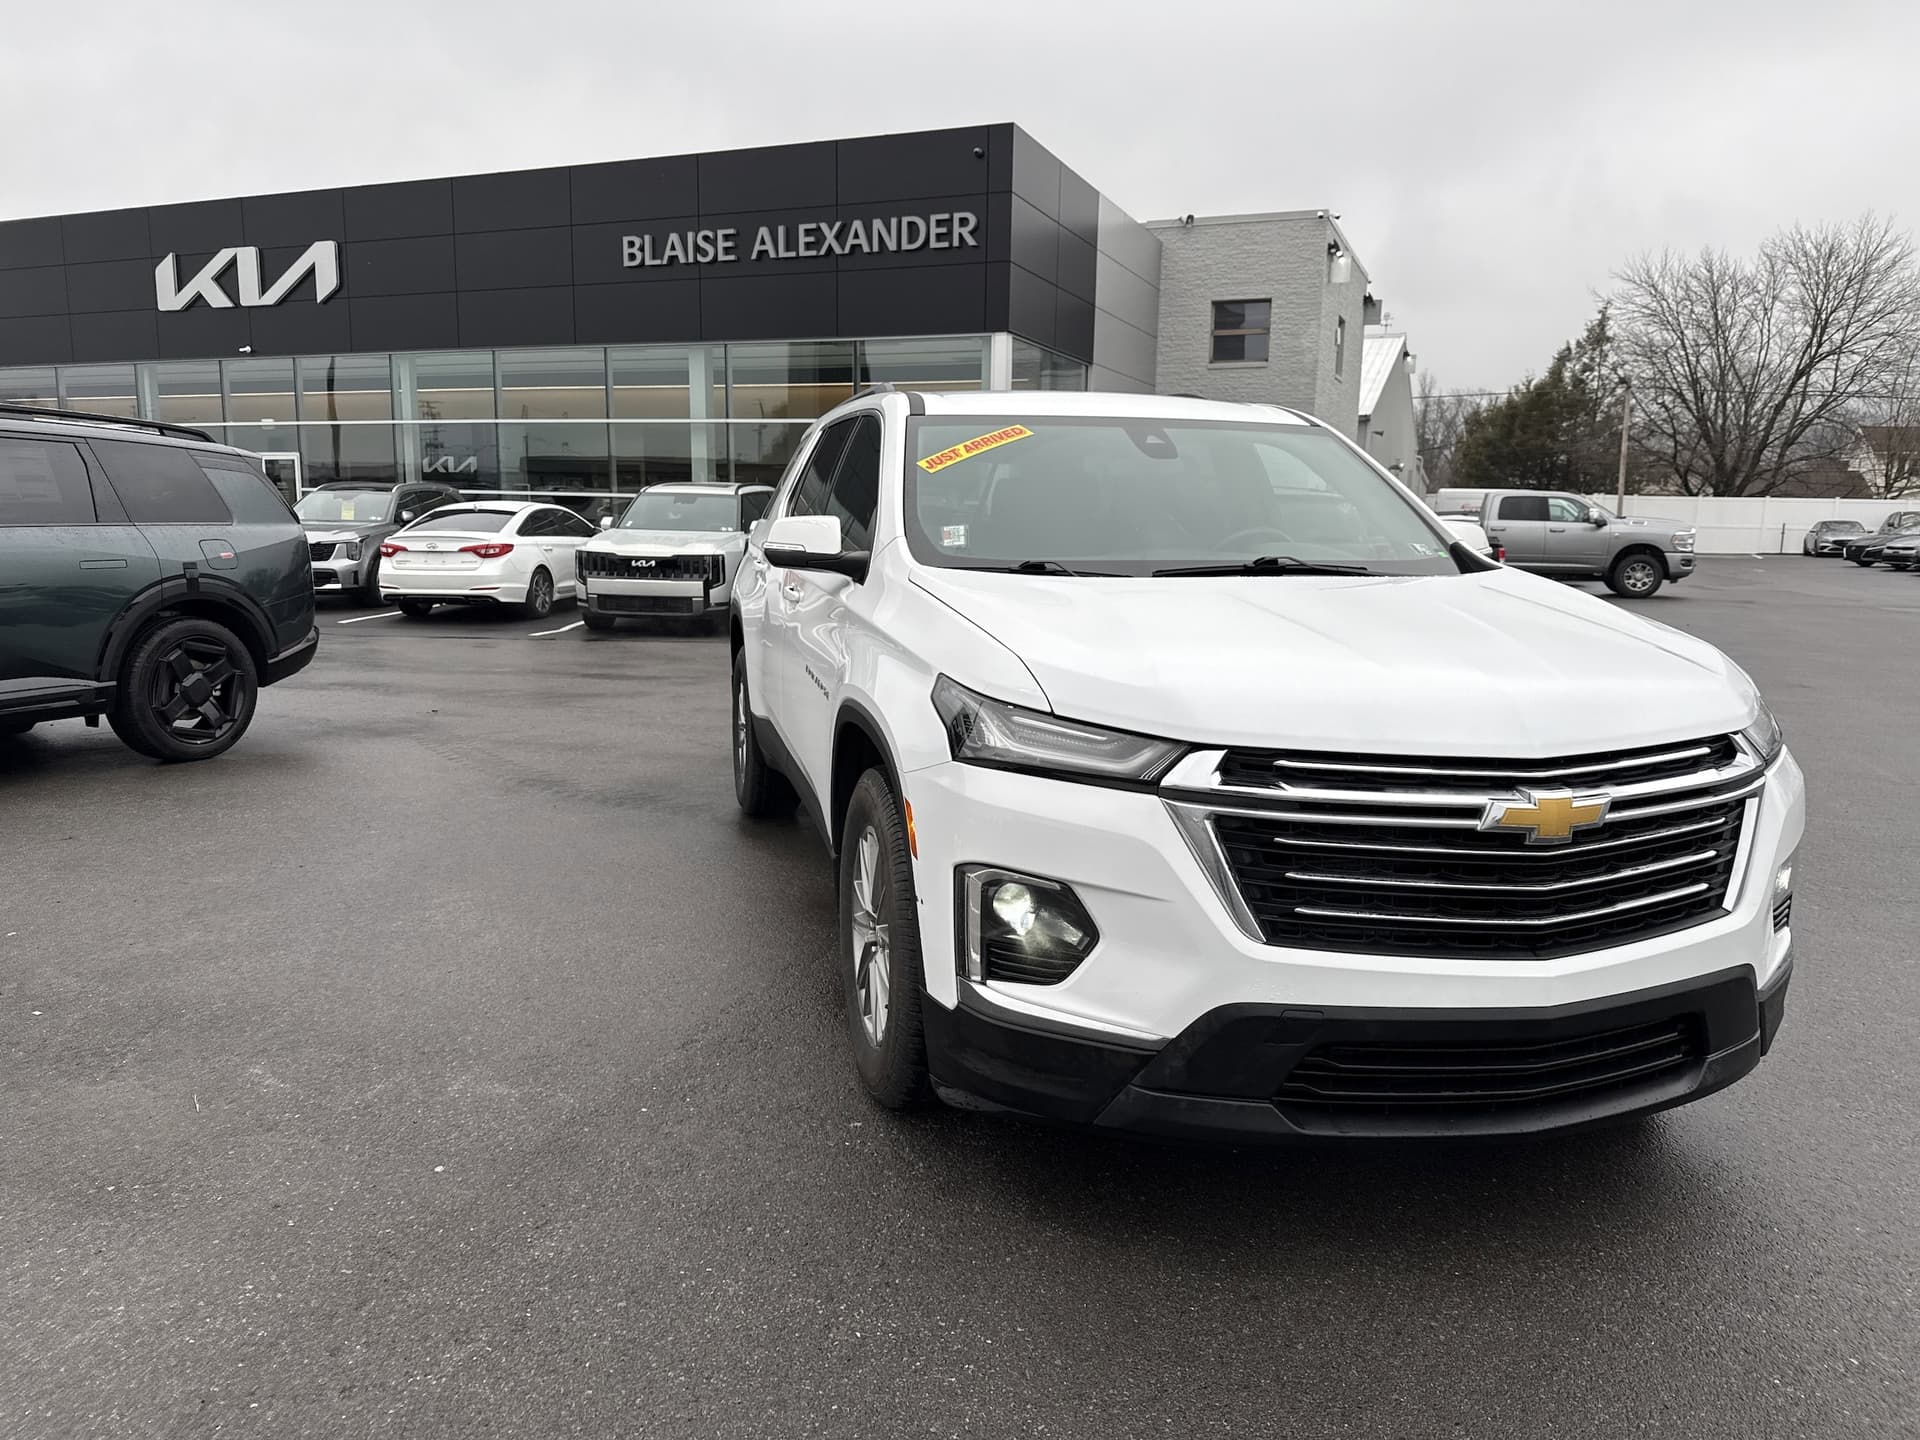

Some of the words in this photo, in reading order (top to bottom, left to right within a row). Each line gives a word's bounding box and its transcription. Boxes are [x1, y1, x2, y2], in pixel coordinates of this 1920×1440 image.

[622, 228, 737, 267] BLAISE
[750, 211, 979, 260] ALEXANDER
[155, 240, 340, 312] KIA
[422, 455, 478, 473] KIA
[925, 448, 962, 470] JUST
[964, 427, 1026, 454] ARRIVED
[631, 559, 656, 567] KIA
